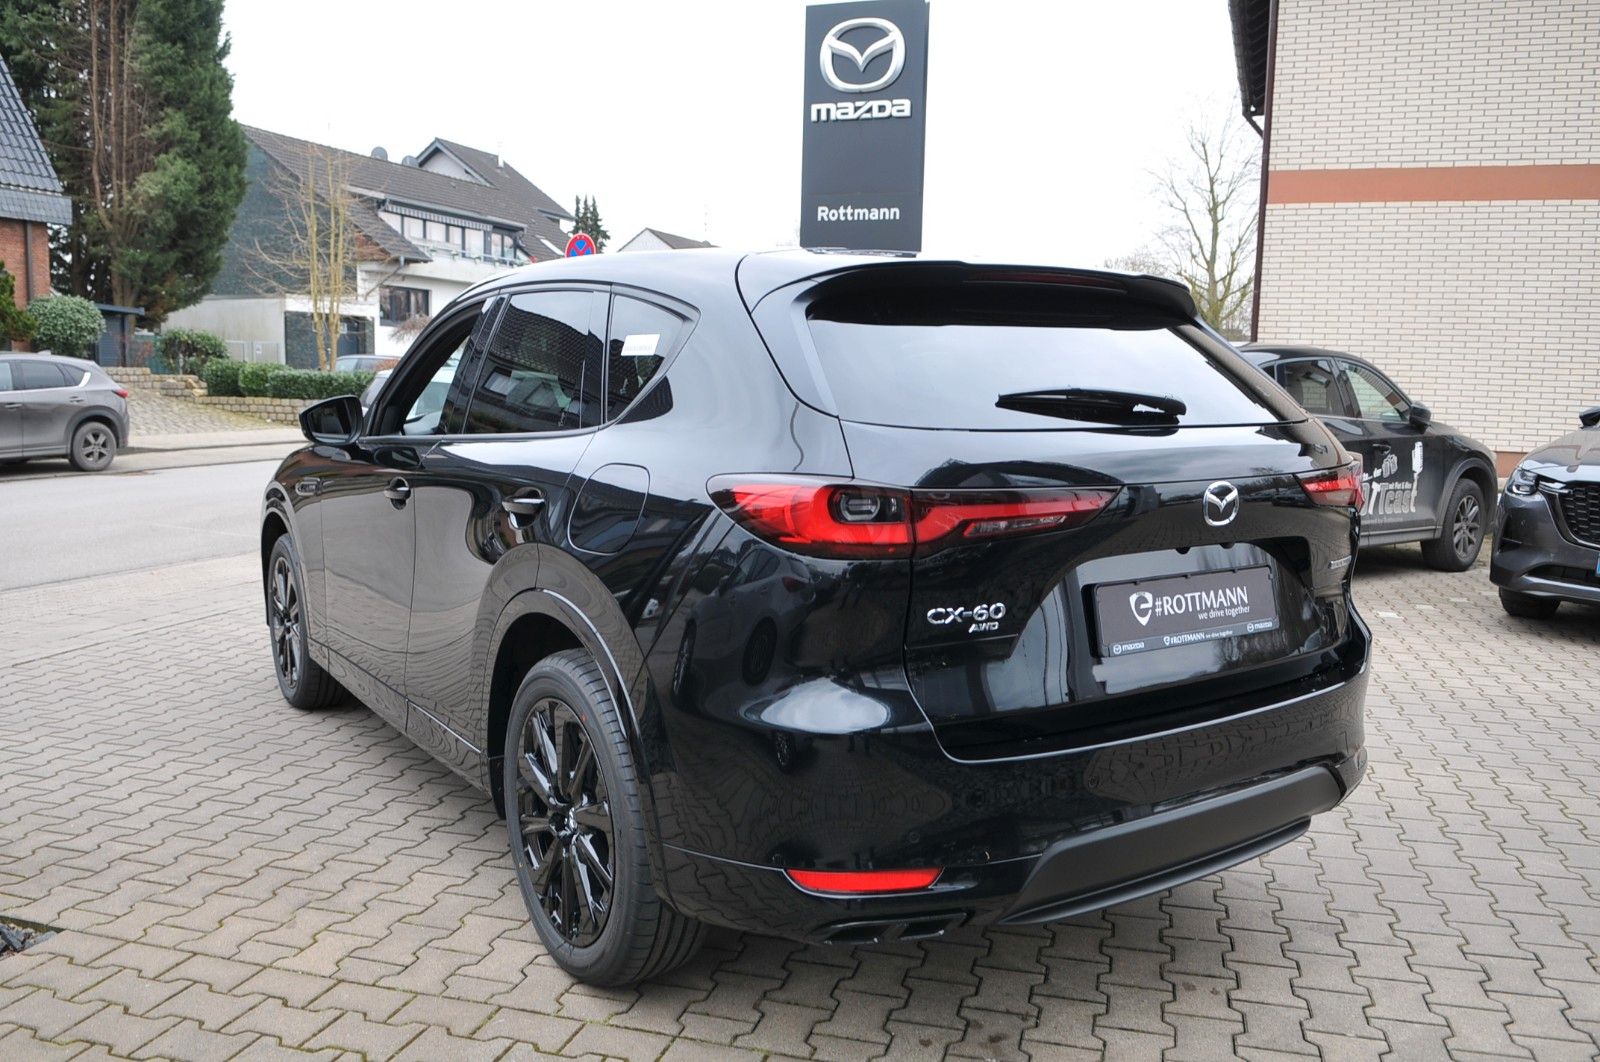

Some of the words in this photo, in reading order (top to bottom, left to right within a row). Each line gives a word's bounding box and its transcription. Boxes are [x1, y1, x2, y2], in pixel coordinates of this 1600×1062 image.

[810, 98, 912, 122] mazda
[817, 205, 900, 222] Rottmann
[1155, 585, 1249, 617] #ROTTMANN
[926, 602, 1006, 625] CX-60
[1198, 612, 1208, 620] we
[1209, 609, 1225, 619] drive
[1225, 605, 1250, 618] together
[968, 621, 999, 633] AWD
[1122, 641, 1145, 651] mazda
[1170, 632, 1205, 645] #ROTTMANN
